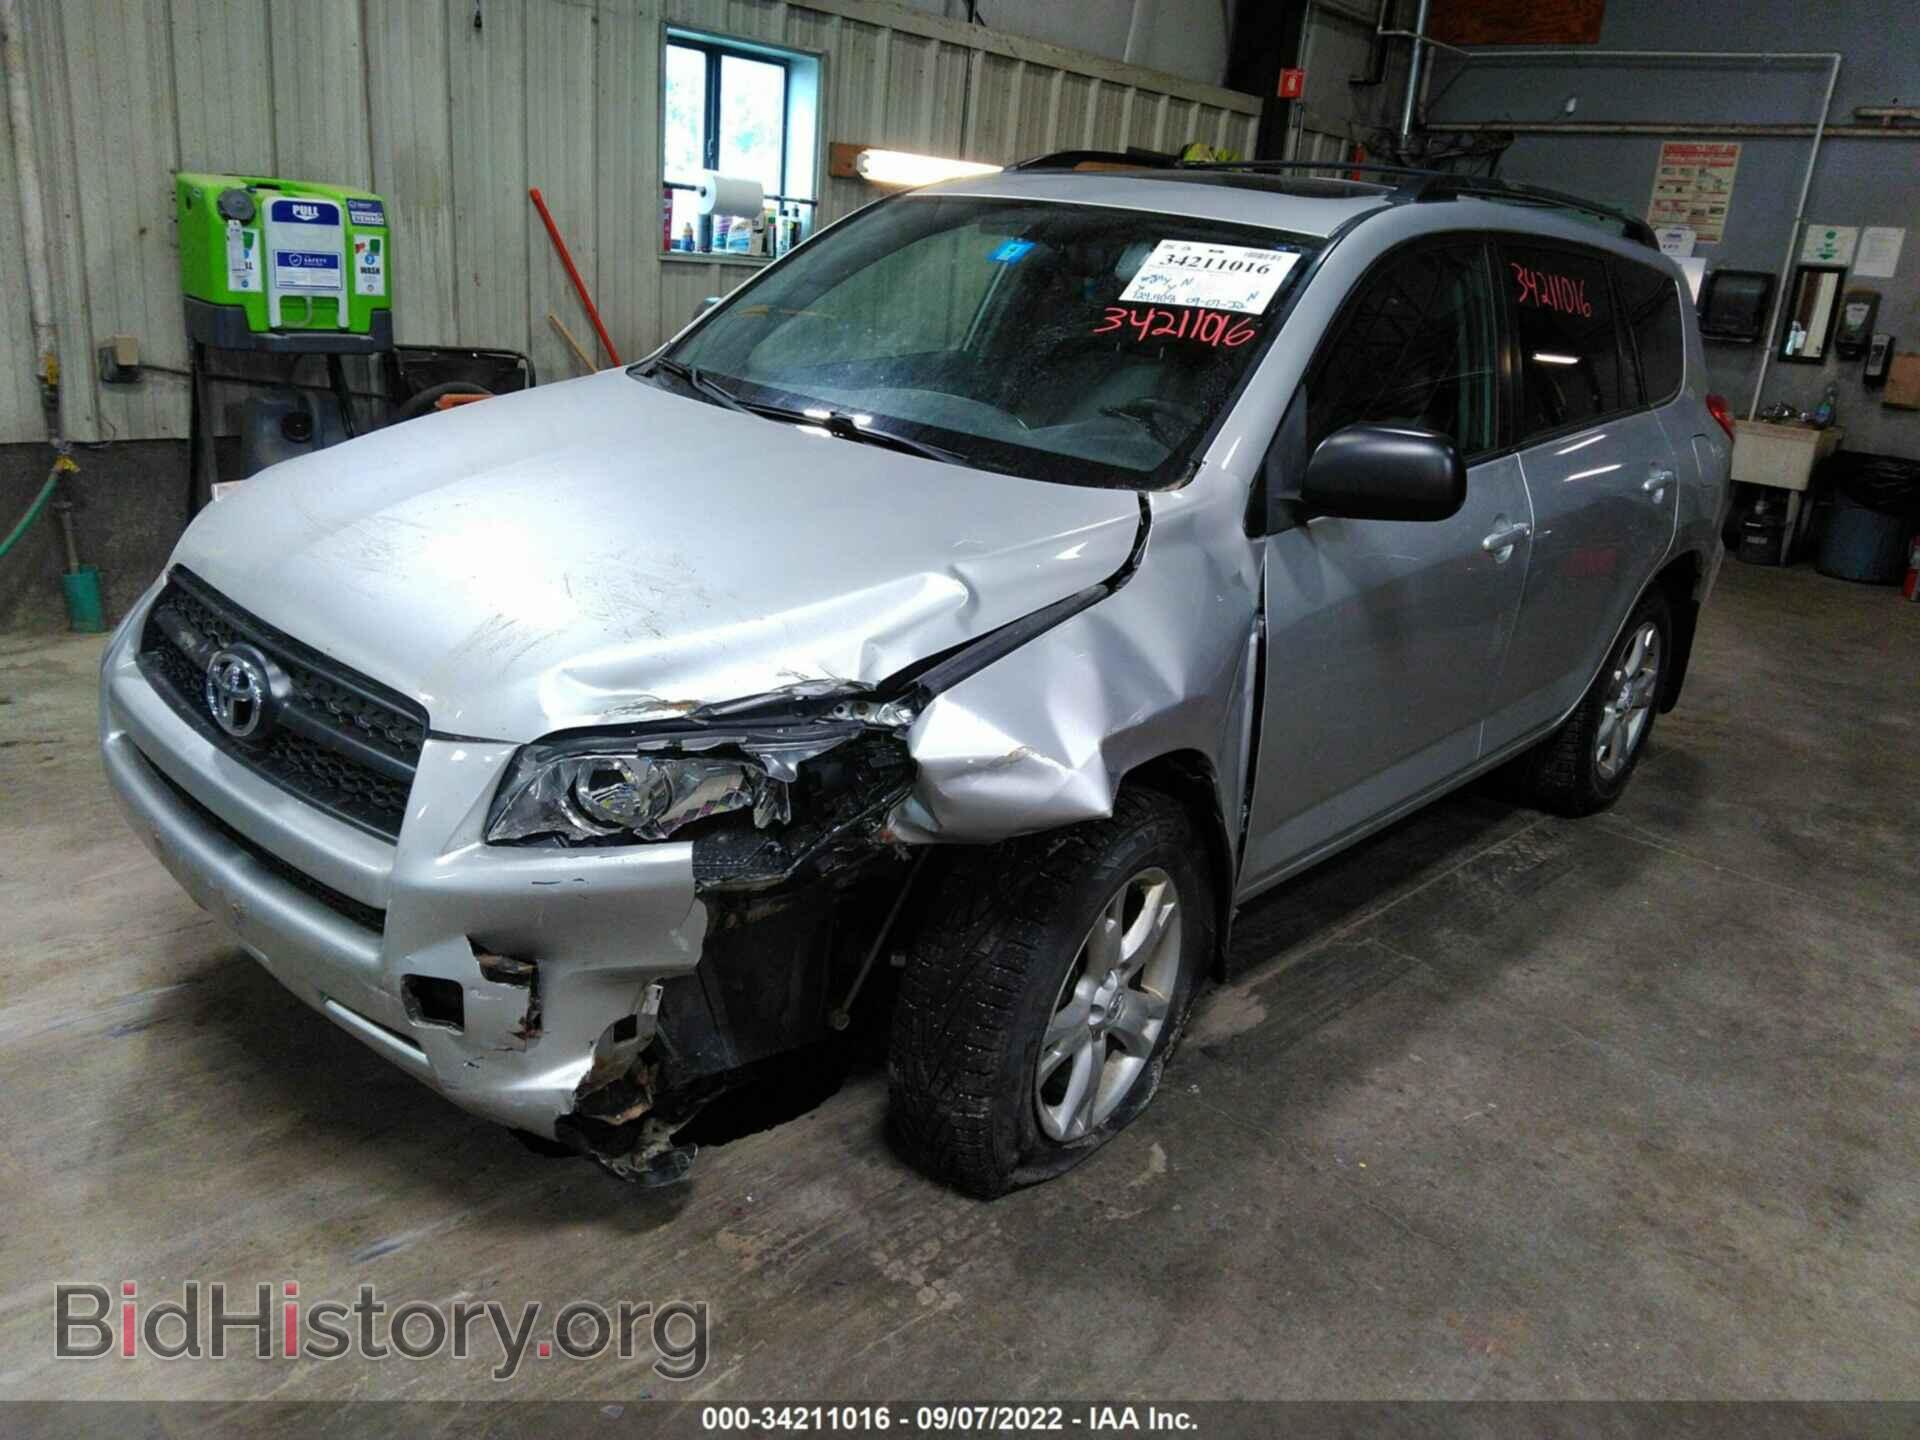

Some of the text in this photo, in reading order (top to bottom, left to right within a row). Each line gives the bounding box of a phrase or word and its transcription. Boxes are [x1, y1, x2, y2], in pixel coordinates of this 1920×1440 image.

[292, 204, 320, 219] PULL
[1158, 253, 1271, 275] 34211016
[1510, 262, 1593, 318] 34211016
[1093, 306, 1257, 347] 34211016
